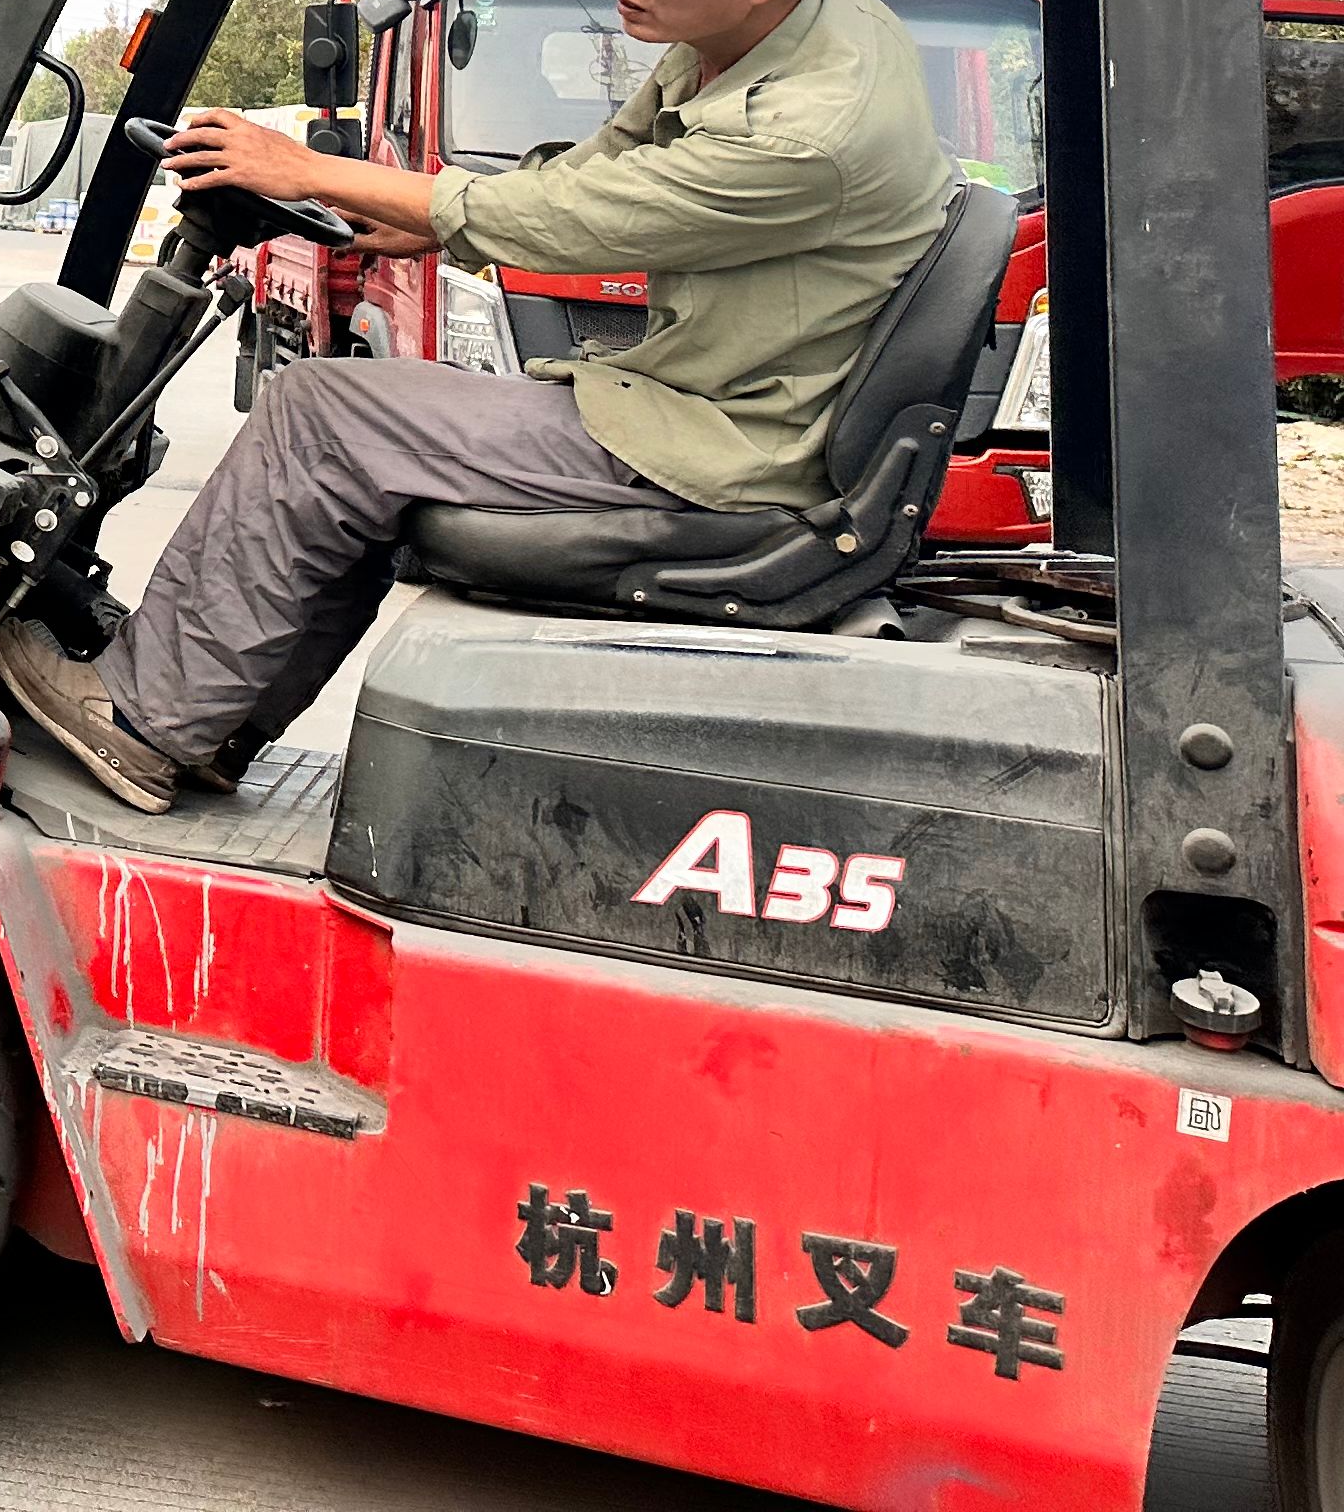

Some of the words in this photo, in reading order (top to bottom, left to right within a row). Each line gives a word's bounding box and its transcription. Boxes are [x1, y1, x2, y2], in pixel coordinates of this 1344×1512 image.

[599, 280, 648, 297] HO
[630, 807, 907, 934] A35
[514, 1182, 1067, 1381] 杭州叉车
